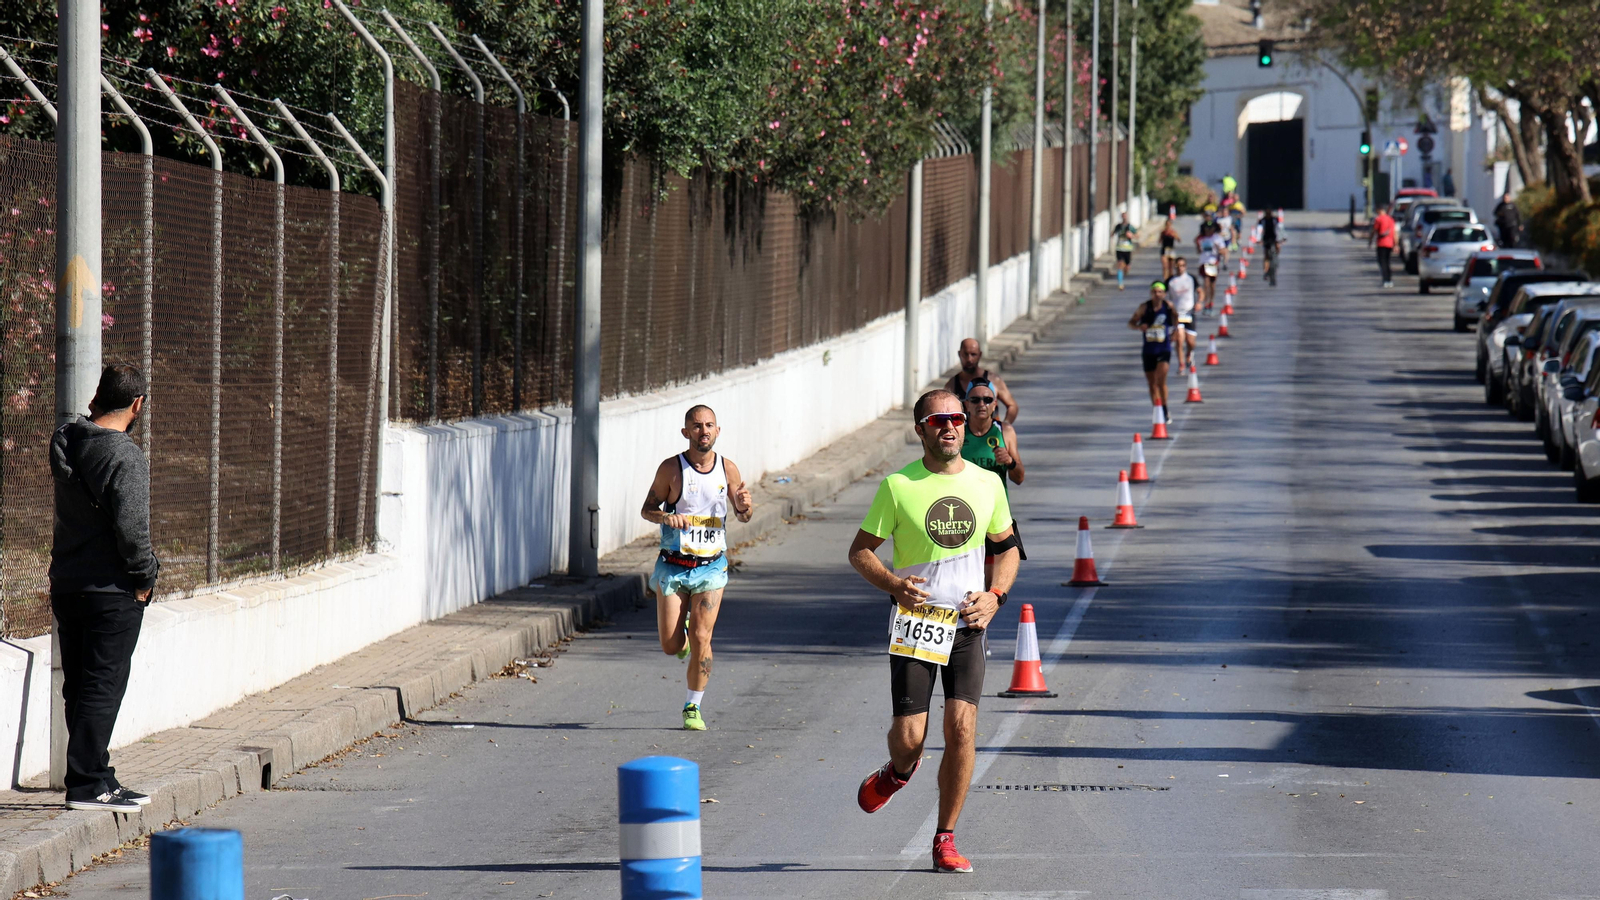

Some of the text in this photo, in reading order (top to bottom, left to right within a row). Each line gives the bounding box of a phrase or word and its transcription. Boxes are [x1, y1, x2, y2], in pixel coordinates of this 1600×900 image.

[929, 519, 973, 533] Sherry
[689, 529, 716, 544] 1196
[903, 619, 945, 645] 1653
